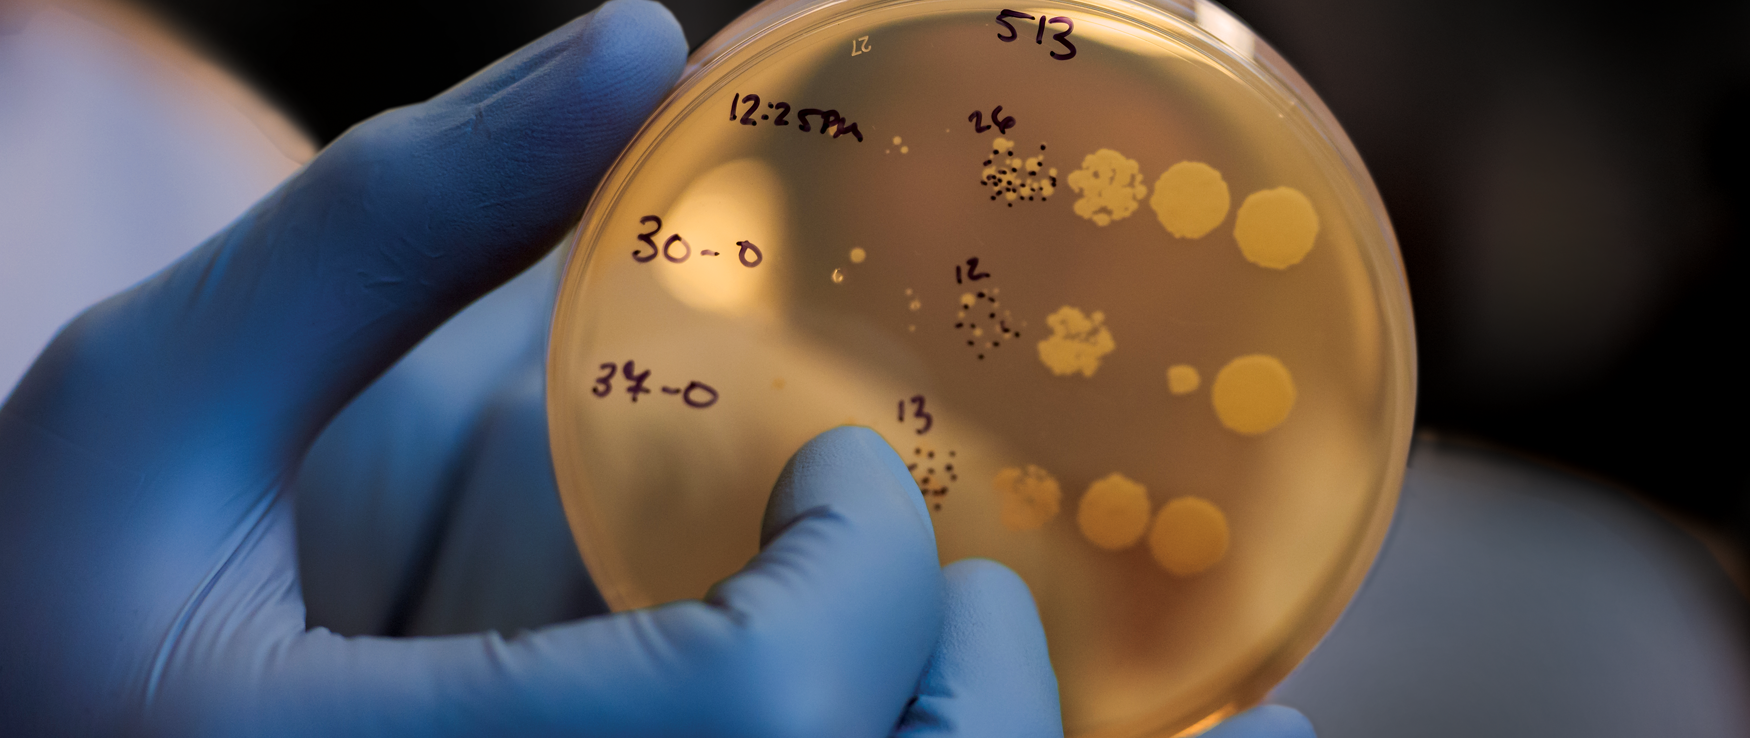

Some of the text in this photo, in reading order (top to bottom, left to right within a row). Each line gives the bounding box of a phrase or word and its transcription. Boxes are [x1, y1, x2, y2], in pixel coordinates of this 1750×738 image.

[851, 35, 872, 57] 27
[995, 9, 1077, 61] 513
[968, 105, 1016, 135] 26
[956, 257, 990, 285] 12
[898, 395, 934, 435] 13
